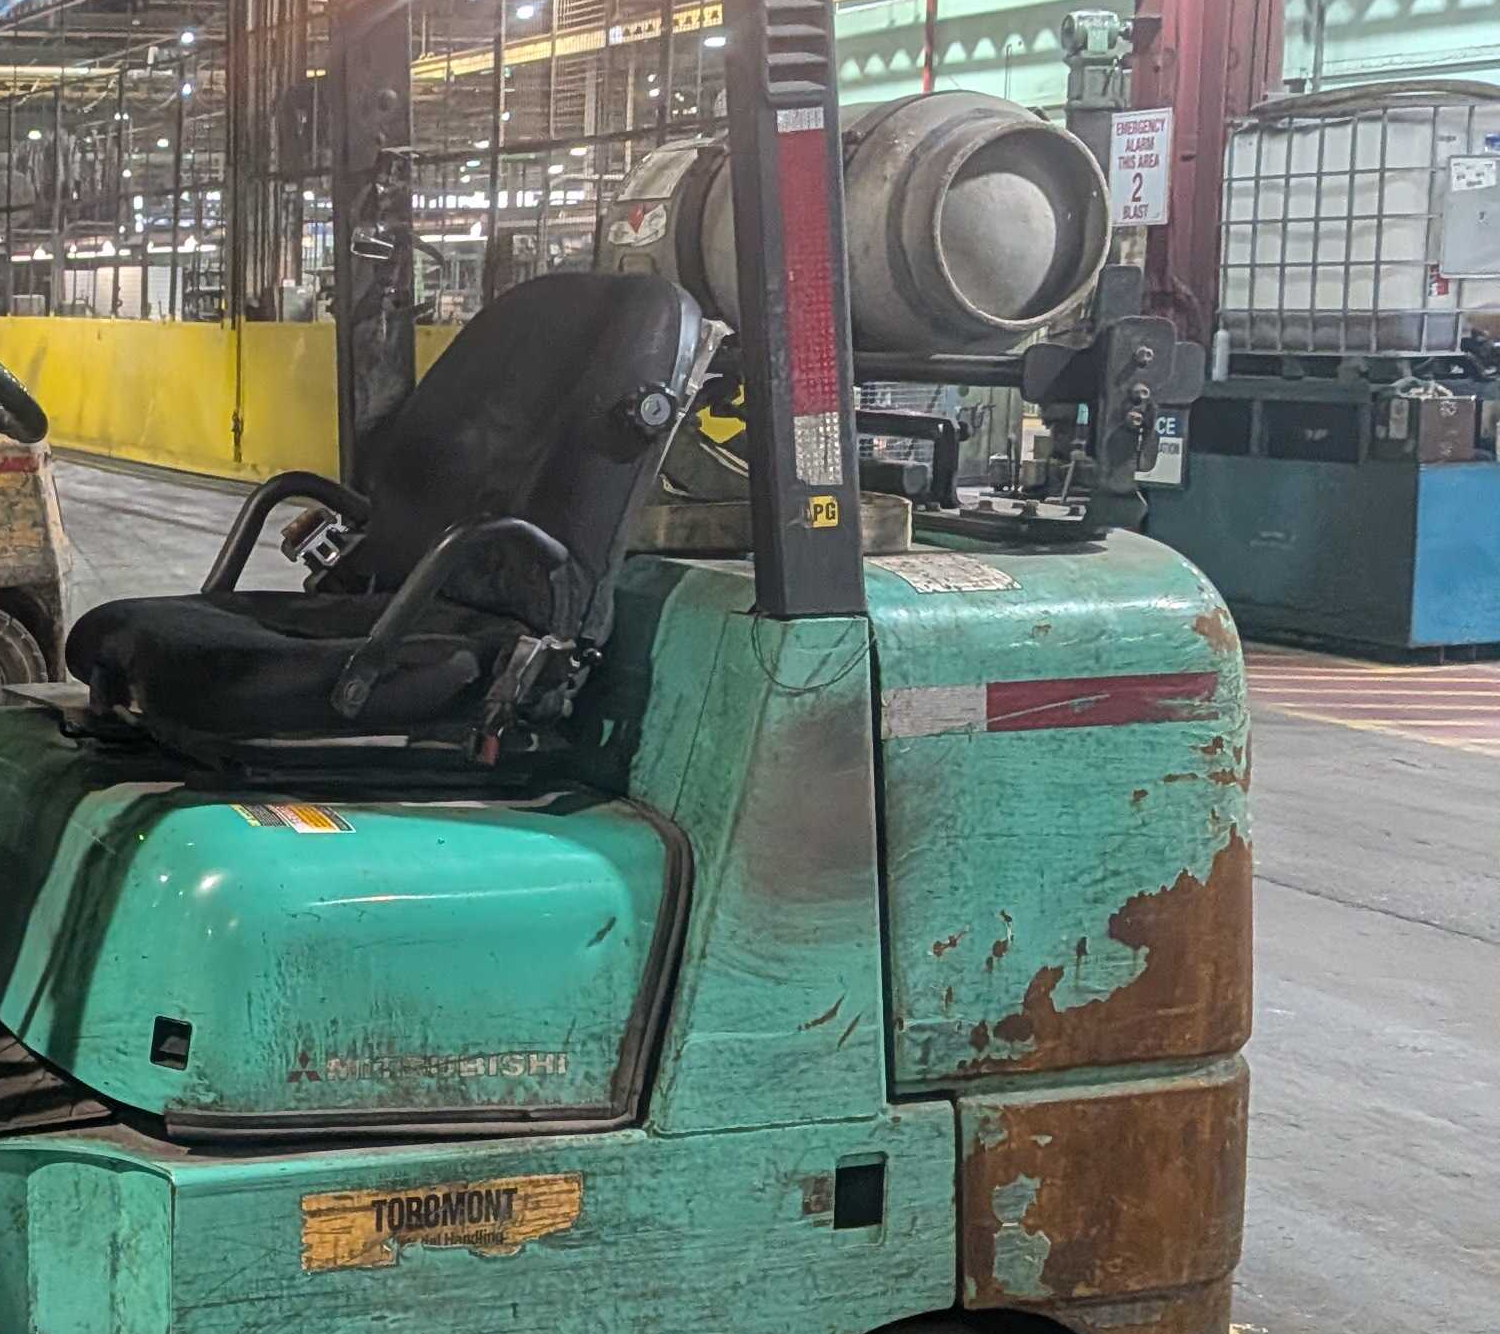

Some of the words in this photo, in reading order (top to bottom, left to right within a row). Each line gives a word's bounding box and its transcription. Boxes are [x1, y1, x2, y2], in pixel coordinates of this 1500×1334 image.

[1116, 119, 1165, 136] EMERGENCY
[1125, 137, 1155, 152] ALARM
[1118, 155, 1136, 170] THIS
[1139, 154, 1160, 168] AREA
[1132, 172, 1143, 202] 2
[1122, 204, 1149, 220] BLAST
[810, 502, 836, 522] PG
[327, 1052, 568, 1081] MITSUBISHI
[371, 1187, 518, 1233] TOROMONT
